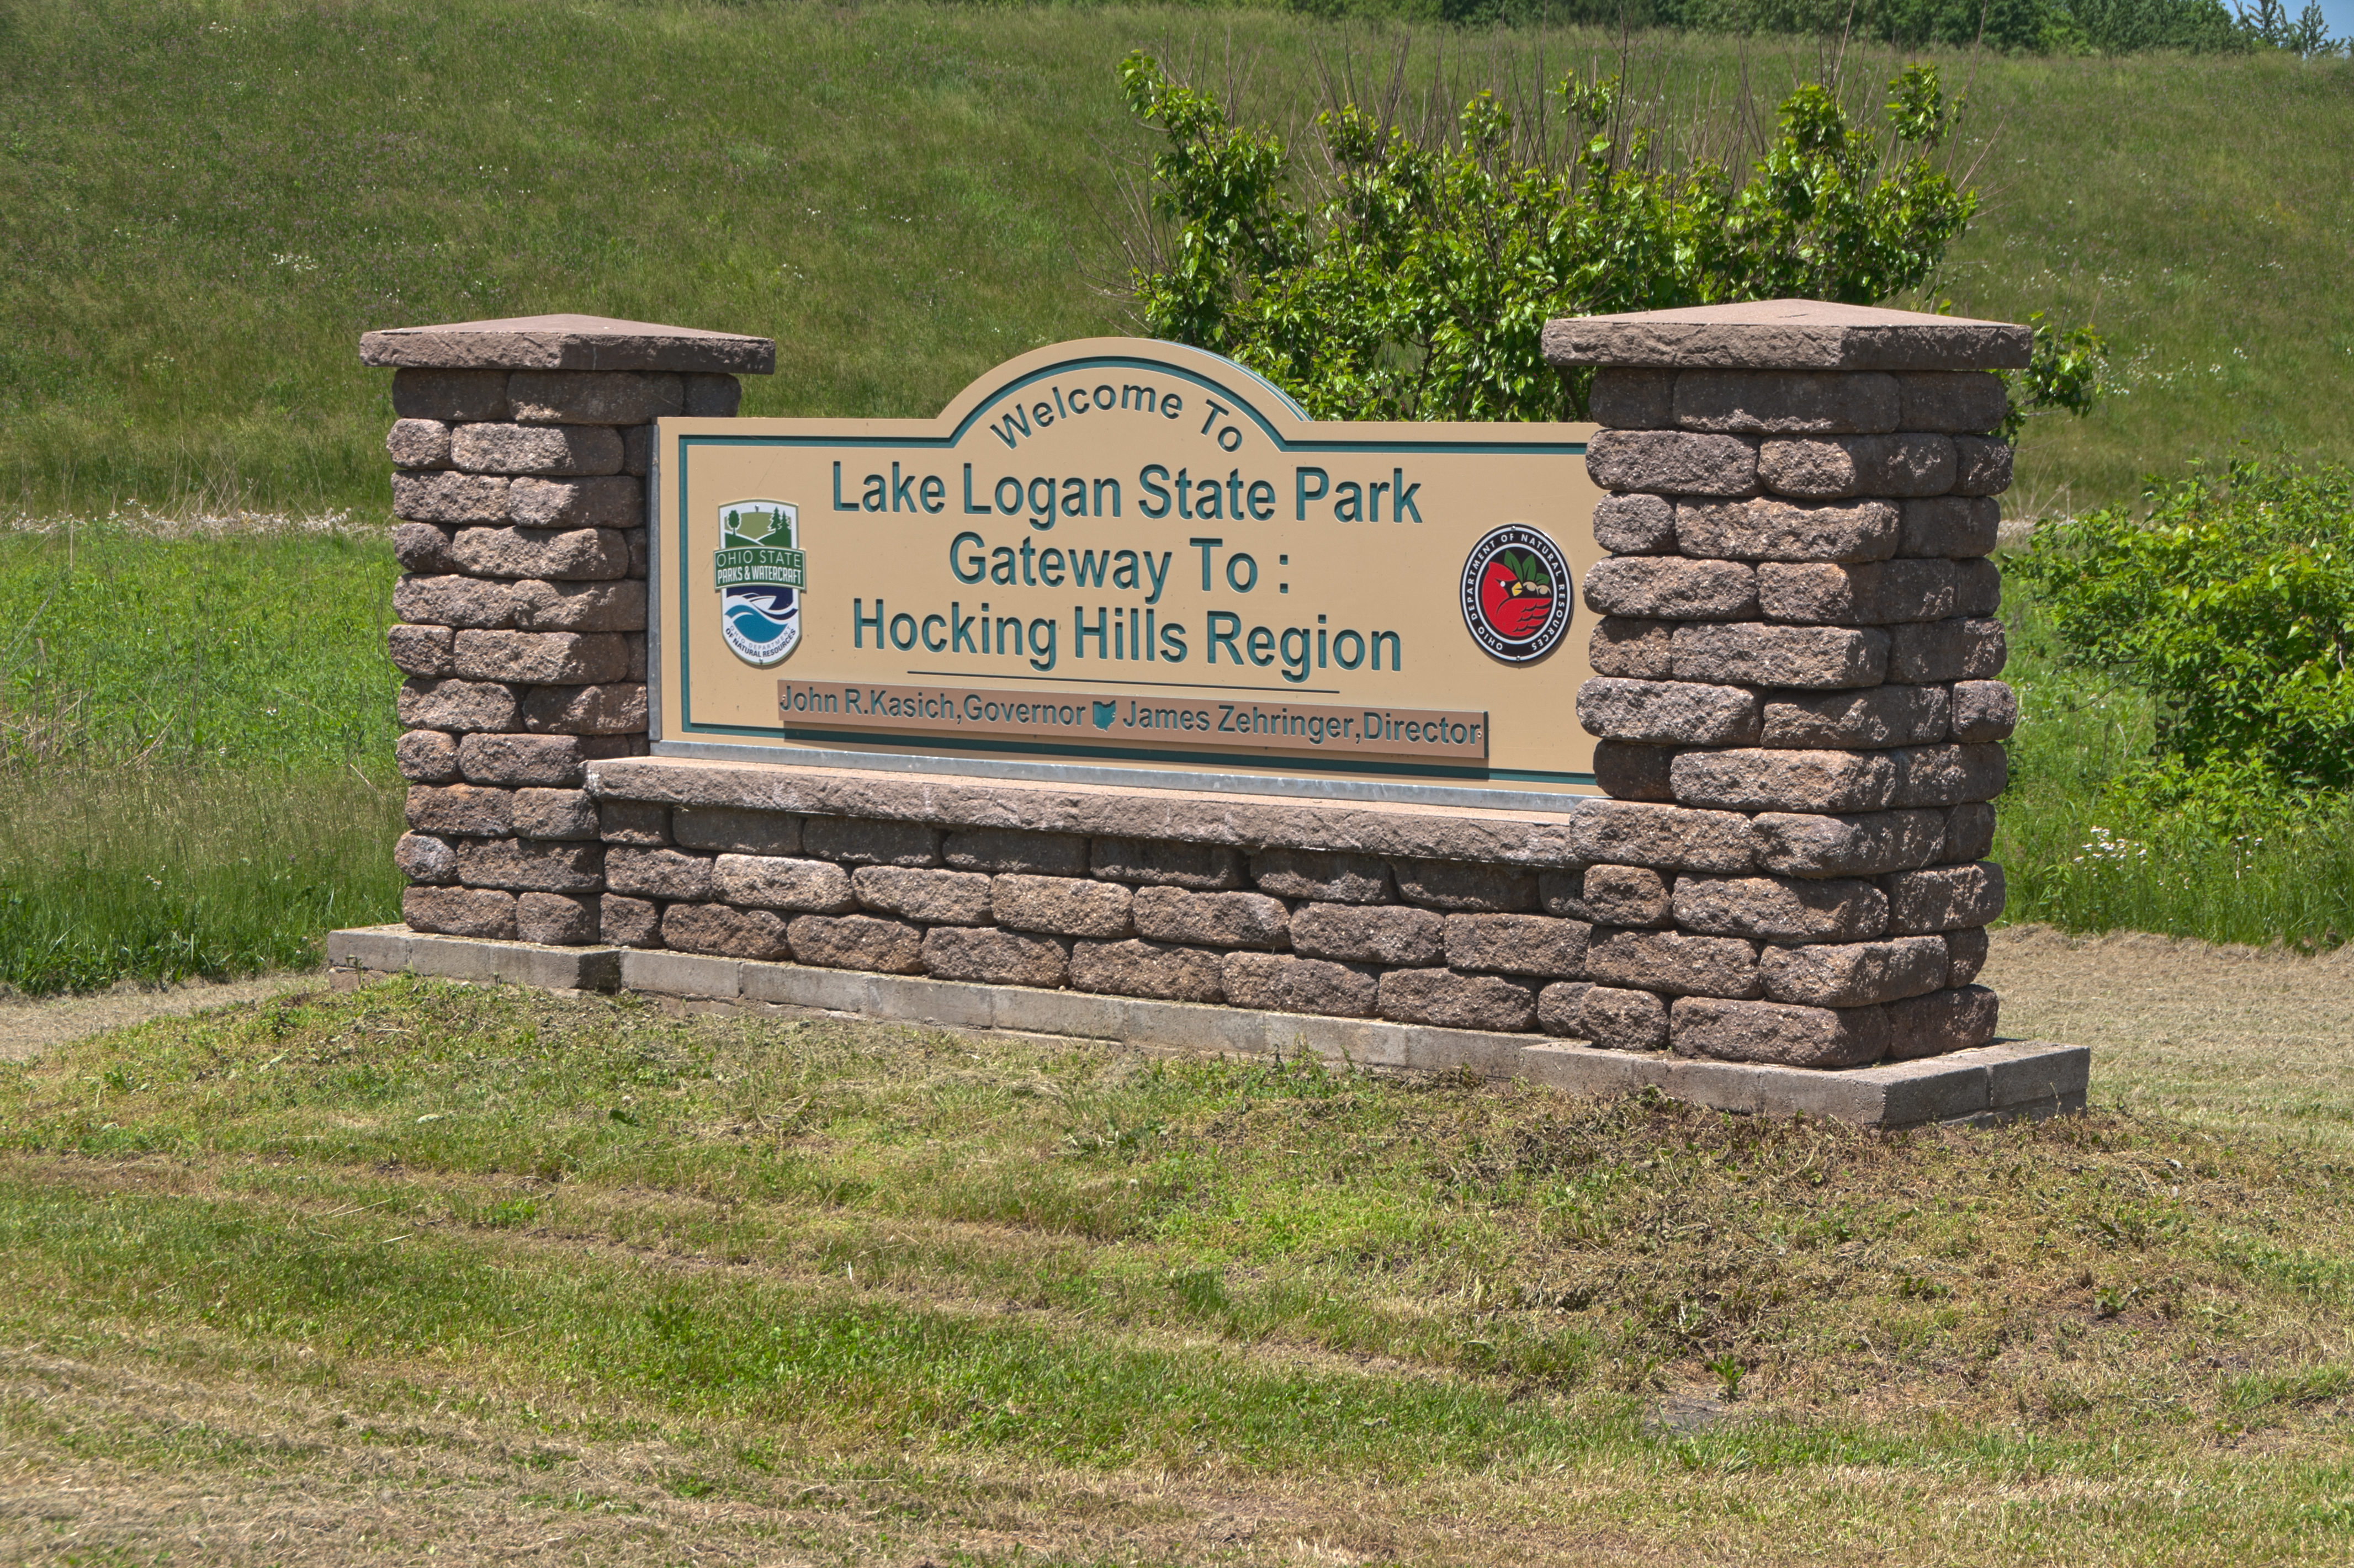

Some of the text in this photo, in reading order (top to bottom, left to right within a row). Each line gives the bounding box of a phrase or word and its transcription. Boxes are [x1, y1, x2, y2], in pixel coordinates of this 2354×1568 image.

[989, 384, 1243, 453] Welcome To
[833, 460, 1423, 531] Lake Logan State Park
[717, 550, 801, 567] OHIO STATE
[718, 565, 802, 584] PARKS & WATERCRAFT
[950, 531, 1173, 605] Gateway
[1467, 533, 1565, 651] OHIO DEPARTMENT OF NATURAL RESOURCES
[725, 628, 796, 657] OF NATURAL RESOURCES
[730, 625, 791, 650] OHIO DEPARTMENT
[854, 598, 1402, 683] Hocking Hills Region
[780, 685, 838, 713] John
[1122, 700, 1211, 732] James
